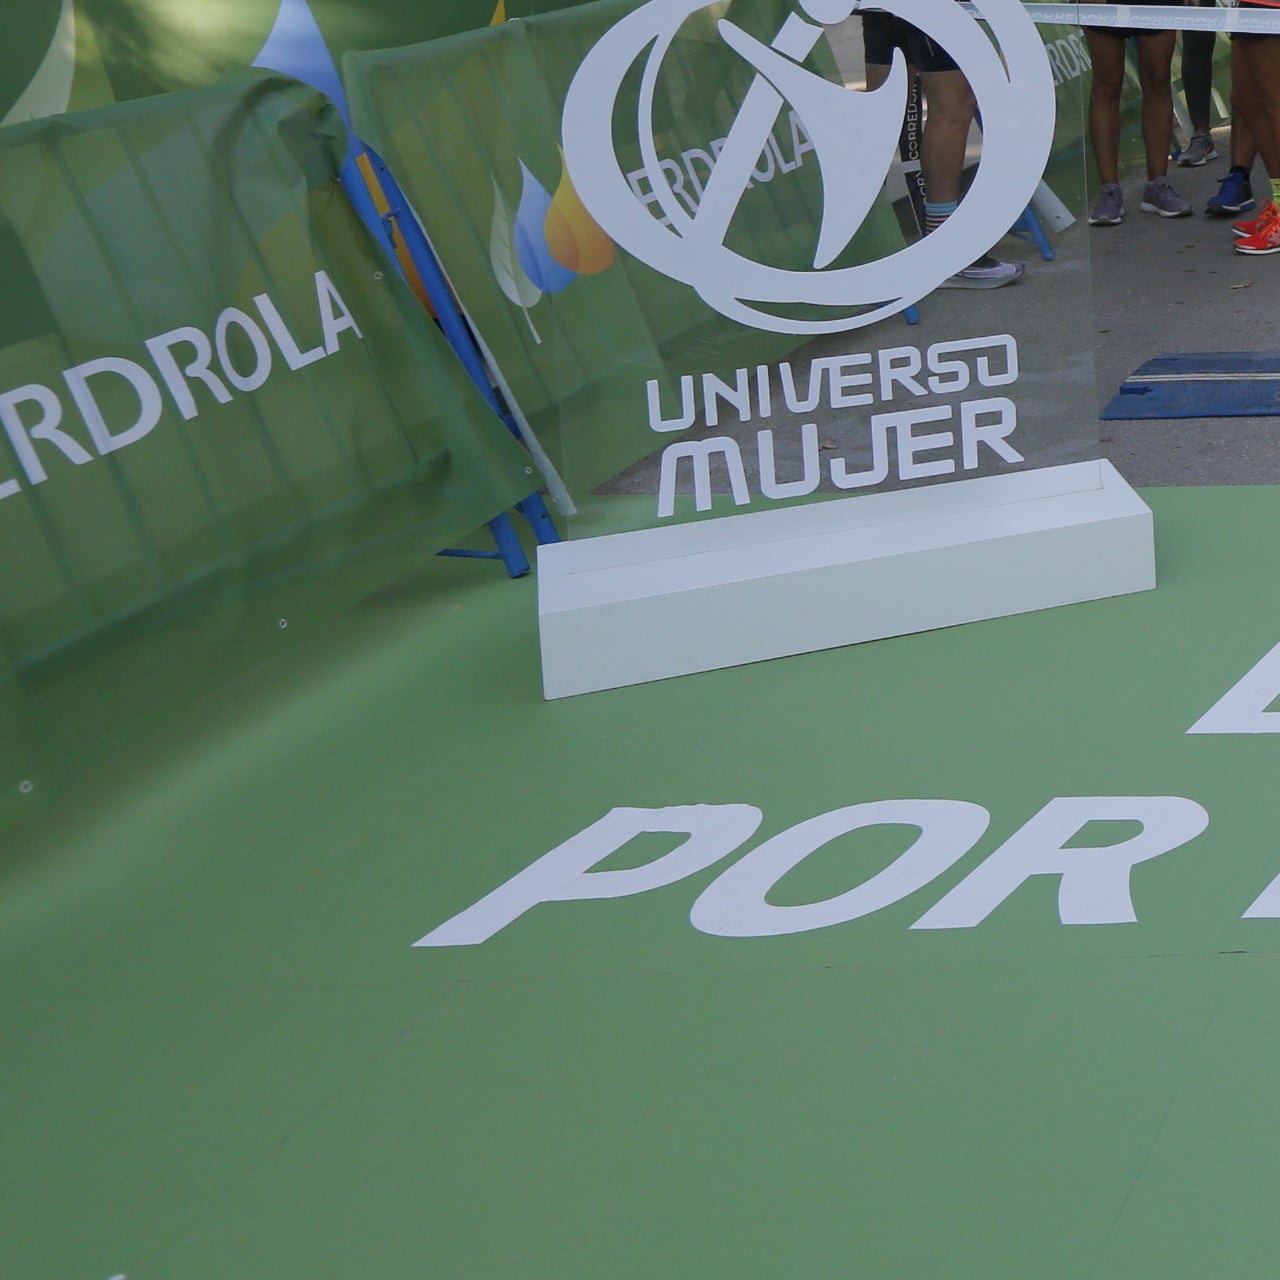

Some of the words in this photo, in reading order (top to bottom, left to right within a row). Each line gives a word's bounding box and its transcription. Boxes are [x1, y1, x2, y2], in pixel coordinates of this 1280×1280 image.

[0, 270, 364, 501] RDROLA
[646, 333, 1018, 433] UNIVERSO
[657, 396, 1024, 518] MUJER
[415, 796, 1209, 947] POR
